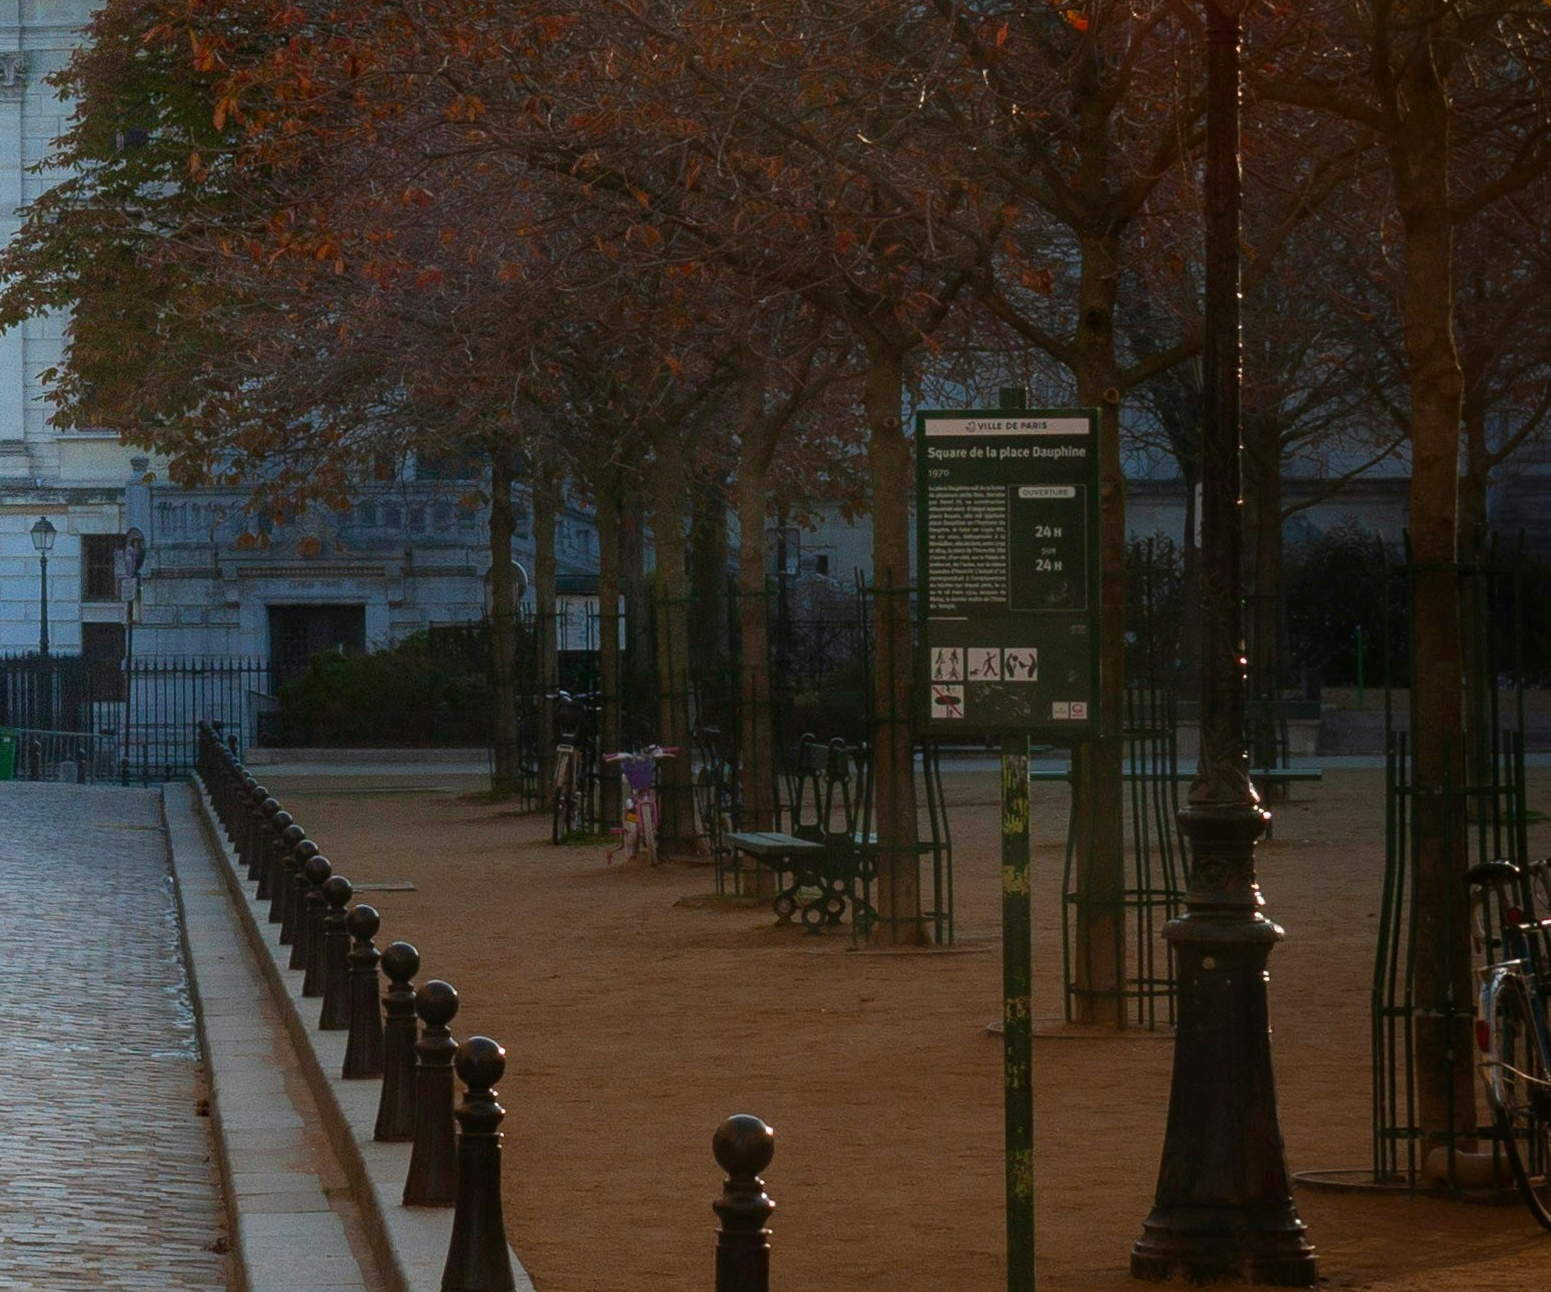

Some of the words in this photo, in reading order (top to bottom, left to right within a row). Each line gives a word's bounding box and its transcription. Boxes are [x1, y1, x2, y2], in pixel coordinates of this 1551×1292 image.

[977, 421, 1002, 431] VILLE
[1006, 421, 1018, 430] DE
[1020, 420, 1048, 430] PARIS
[927, 446, 967, 460] Square
[969, 446, 984, 458] de
[986, 446, 997, 458] la
[999, 446, 1030, 460] place
[1032, 445, 1087, 460] Dauphine
[1022, 488, 1070, 496] OUVERTURE
[1034, 525, 1052, 538] 24
[1053, 527, 1062, 538] H
[1035, 559, 1052, 571] 24
[1054, 560, 1063, 571] H
